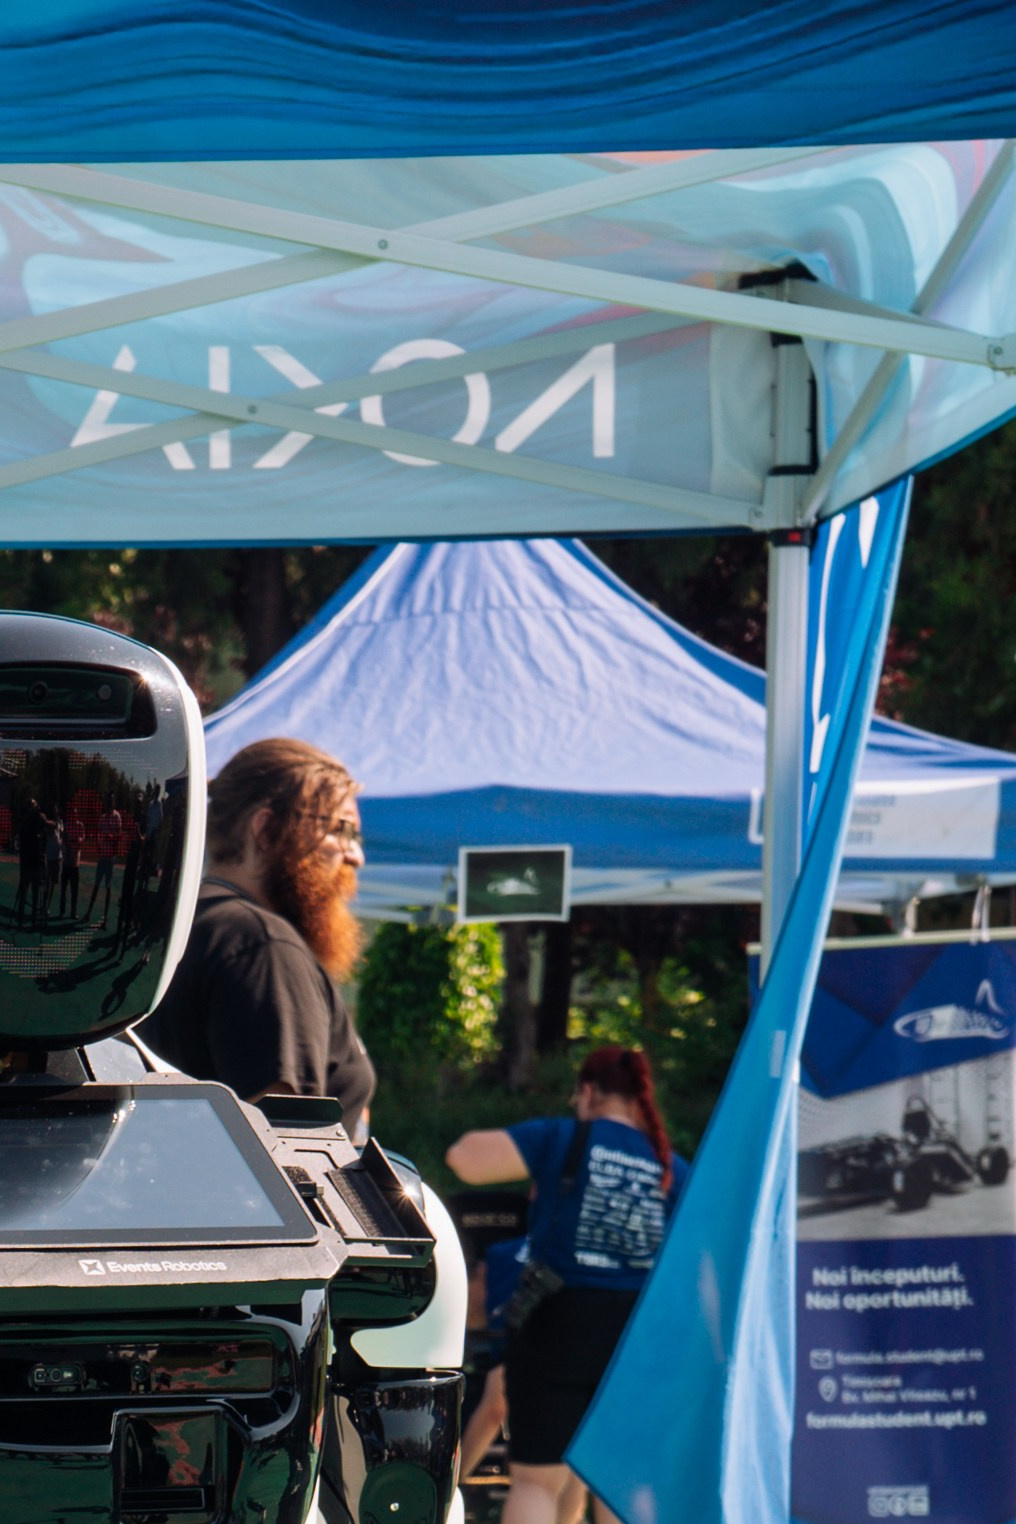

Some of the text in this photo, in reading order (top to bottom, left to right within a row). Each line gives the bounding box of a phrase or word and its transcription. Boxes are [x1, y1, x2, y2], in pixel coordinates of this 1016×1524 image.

[106, 1259, 228, 1273] Events Robotics
[812, 1266, 846, 1286] Noi
[805, 1290, 840, 1310] Noi
